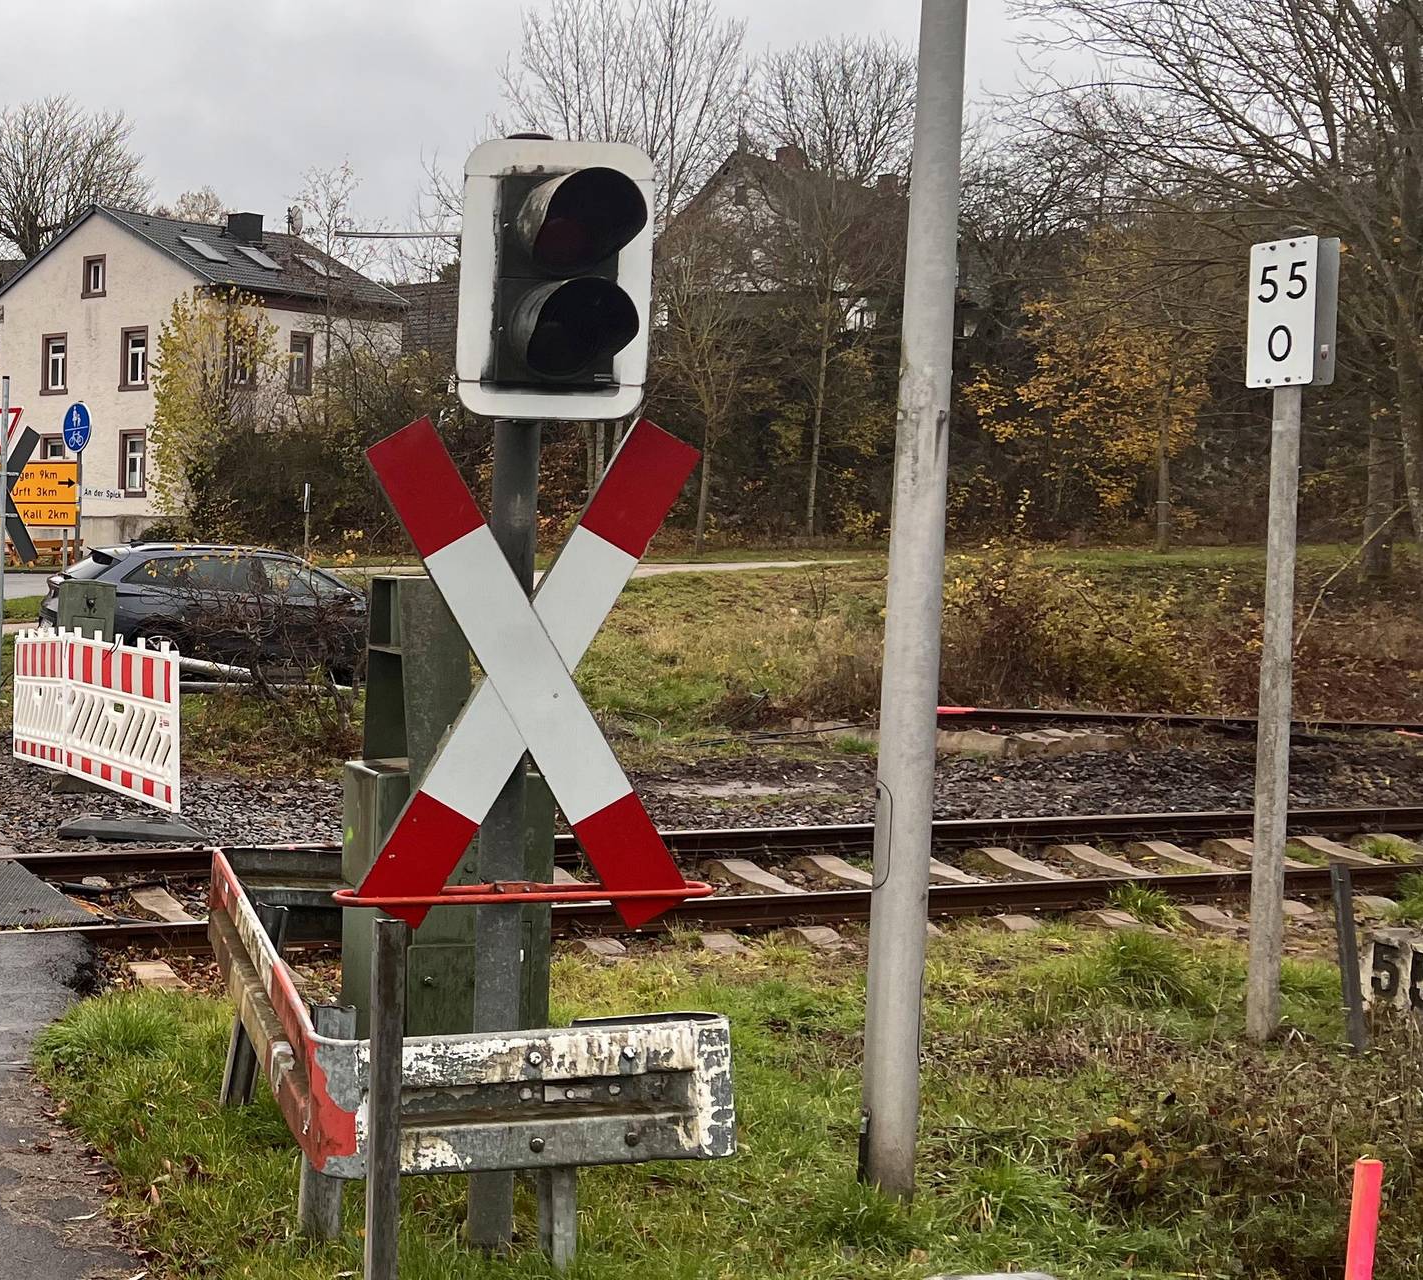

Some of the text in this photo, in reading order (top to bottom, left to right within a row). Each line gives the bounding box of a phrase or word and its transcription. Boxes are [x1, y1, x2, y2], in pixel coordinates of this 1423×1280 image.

[1258, 260, 1307, 303] 55
[1268, 324, 1292, 362] 0
[20, 470, 58, 482] gen 9km
[12, 487, 57, 497] Urft 3km
[84, 488, 92, 496] An
[94, 489, 104, 497] der
[23, 509, 69, 519] Kall 2km
